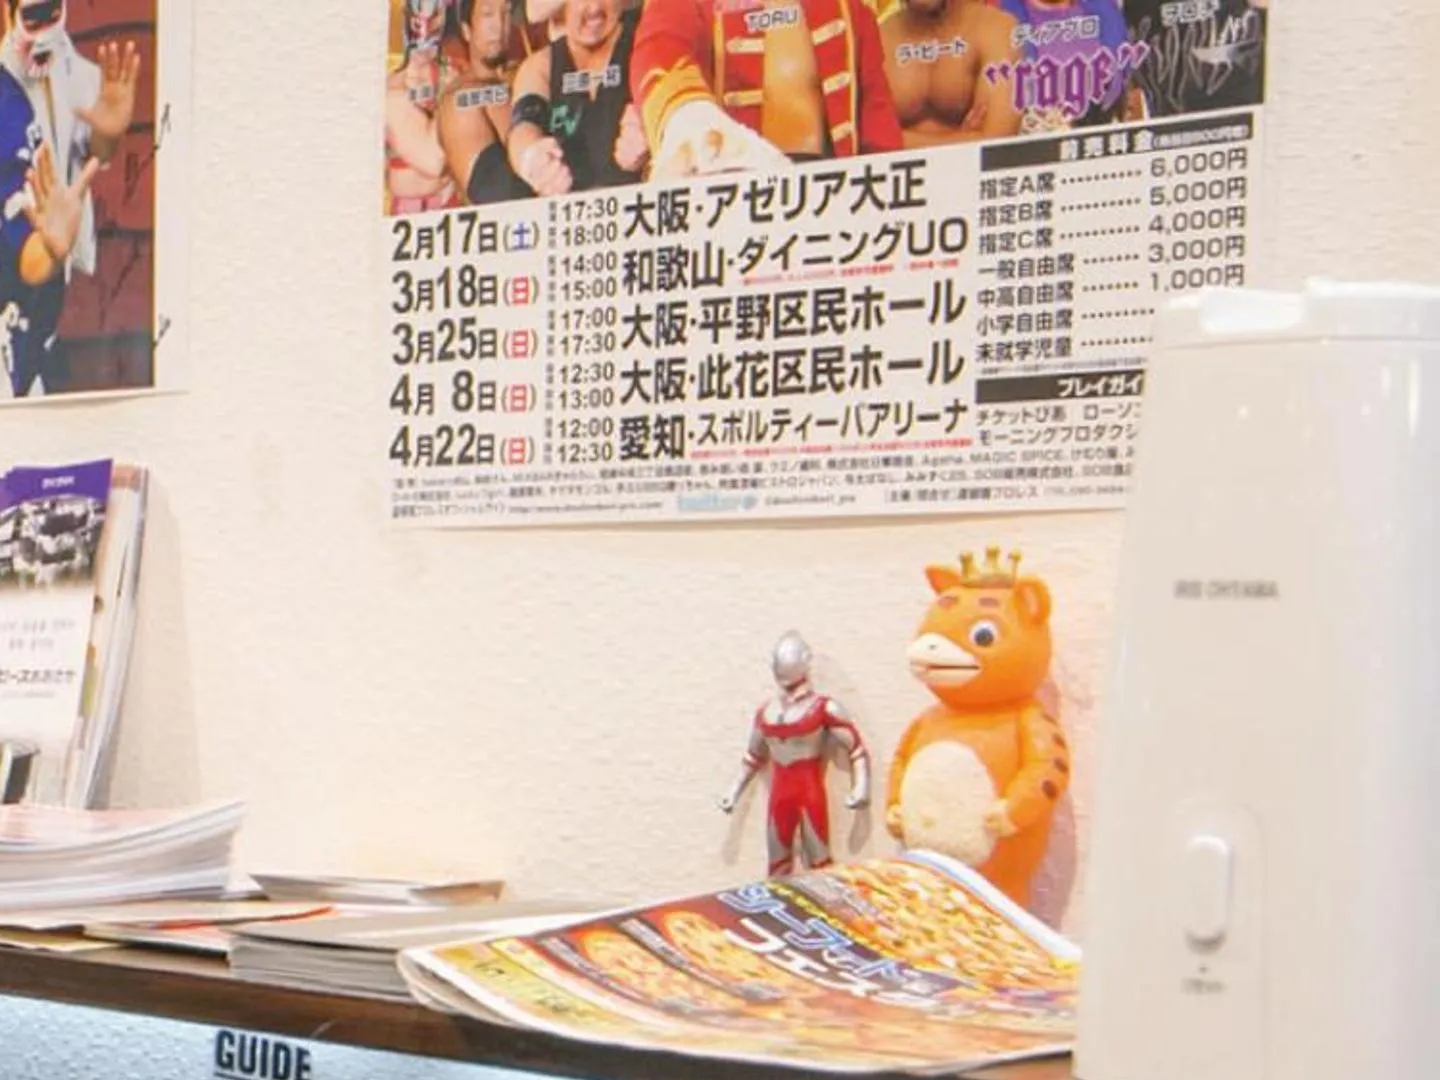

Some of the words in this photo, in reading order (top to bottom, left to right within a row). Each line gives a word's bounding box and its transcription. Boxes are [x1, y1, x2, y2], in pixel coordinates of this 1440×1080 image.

[562, 197, 618, 222] 17:30
[562, 222, 618, 246] 18:00
[561, 251, 617, 276] 14:00
[561, 276, 617, 301] 15:00
[561, 306, 617, 330] 17:00
[560, 332, 616, 356] 17:30
[559, 361, 615, 385] 12:30
[559, 386, 615, 410] 13:00
[557, 416, 614, 439] 12:00
[557, 442, 614, 464] 12:30
